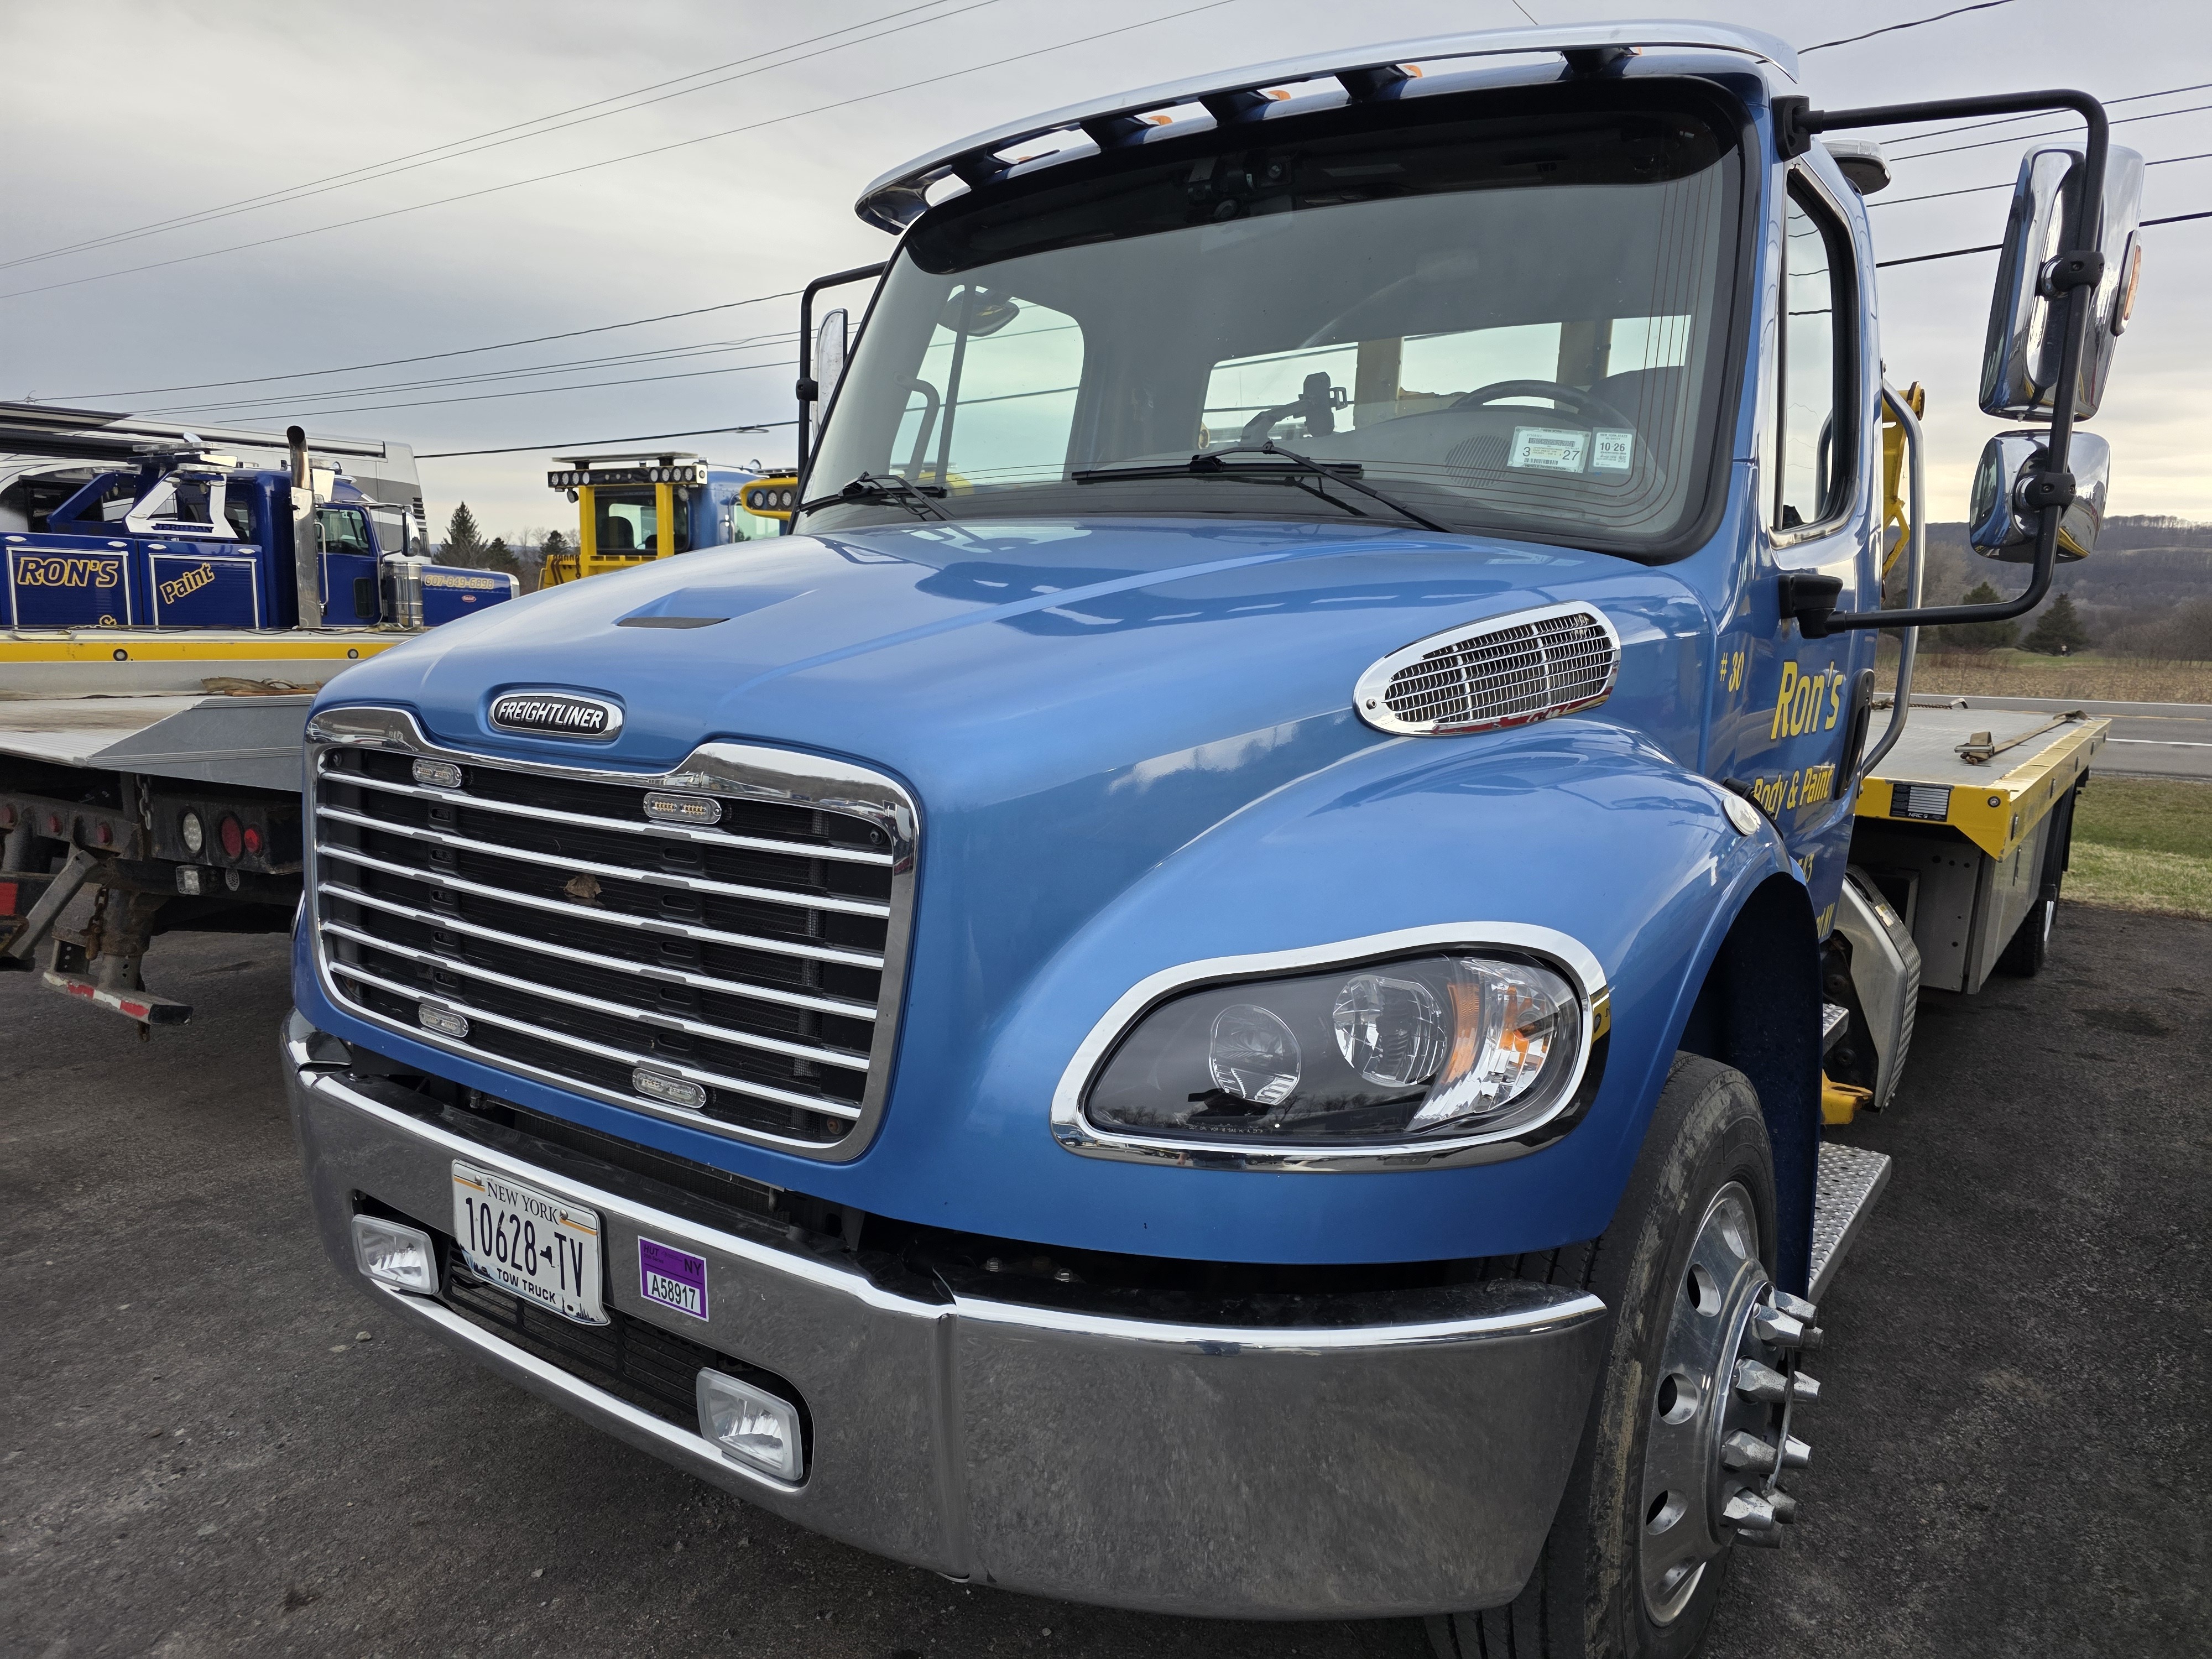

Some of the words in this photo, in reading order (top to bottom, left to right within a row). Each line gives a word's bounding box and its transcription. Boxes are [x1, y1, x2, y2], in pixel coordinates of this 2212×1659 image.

[1522, 447, 1531, 457] 3
[1562, 450, 1580, 461] 27
[17, 557, 119, 587] RON'S
[160, 562, 215, 604] Paint
[425, 575, 494, 589] 607-849-6898
[498, 702, 604, 729] FREIGHTLINER
[1771, 661, 1843, 739] Ron's
[1753, 774, 1788, 821] Body
[1787, 770, 1799, 809] &
[1799, 764, 1835, 806] Paint
[487, 1182, 519, 1207] NEW
[521, 1195, 560, 1225] YORK
[466, 1197, 536, 1276] 10628
[554, 1232, 583, 1298] TV
[644, 1244, 659, 1256] HUT
[684, 1258, 702, 1276] NY
[497, 1267, 519, 1287] TOW
[522, 1280, 556, 1305] TRUCK
[651, 1275, 696, 1310] A58917
